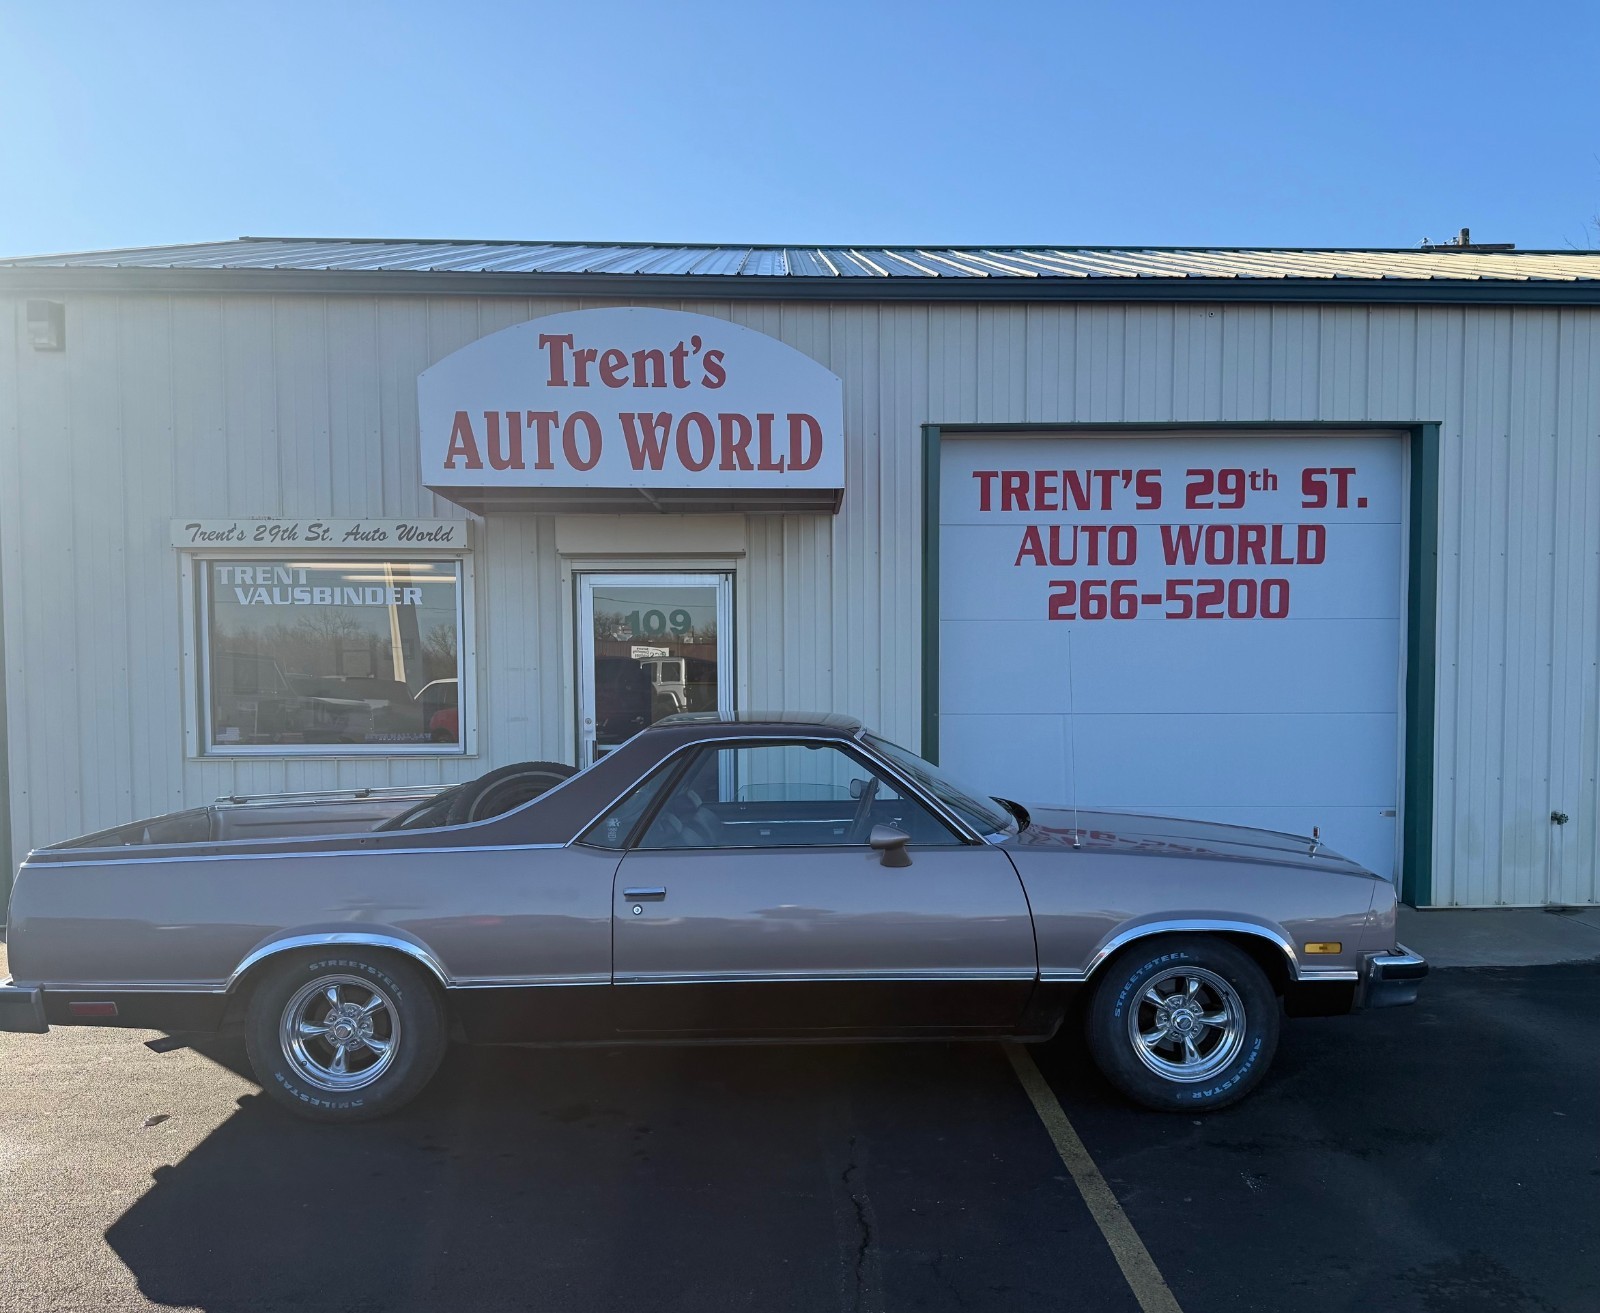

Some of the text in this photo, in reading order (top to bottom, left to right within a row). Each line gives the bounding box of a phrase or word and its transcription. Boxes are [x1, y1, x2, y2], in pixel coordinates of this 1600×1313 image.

[538, 333, 727, 389] Trent's
[443, 410, 824, 473] AUTO WORLD
[972, 467, 1369, 512] TRENT'S 29th ST.
[185, 522, 455, 544] Trent's 29th St. Auto World
[1014, 524, 1326, 567] AUTO WORLD
[216, 566, 310, 585] TRENT
[234, 587, 423, 606] VAUSBINDER
[1047, 578, 1290, 621] 266-5200
[624, 609, 692, 635] 109
[308, 959, 403, 1001] STREETSTEEL
[1114, 952, 1190, 1019] STREETSTEEL
